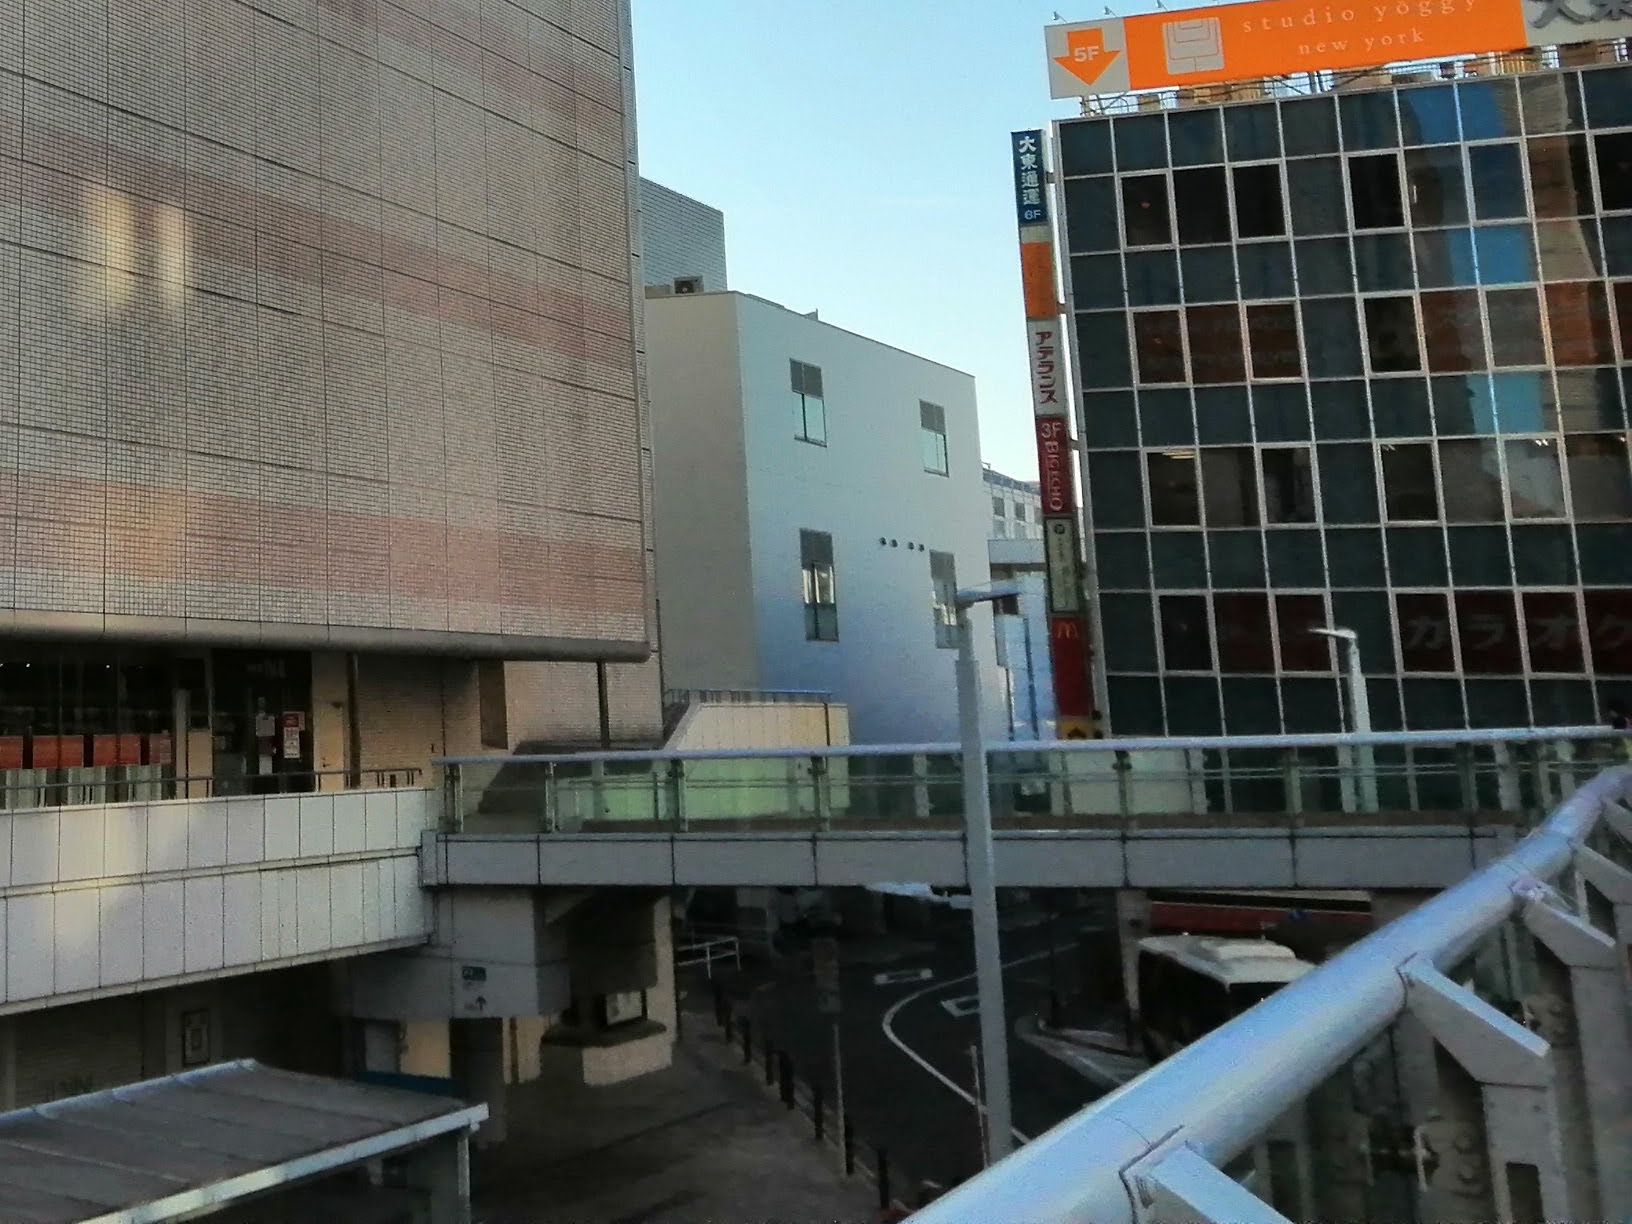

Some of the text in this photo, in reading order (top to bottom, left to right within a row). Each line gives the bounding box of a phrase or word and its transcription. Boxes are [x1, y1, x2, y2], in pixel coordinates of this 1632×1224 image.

[1242, 1, 1355, 33] studio
[1298, 28, 1426, 56] new york
[1074, 45, 1100, 63] 5F
[1018, 135, 1041, 206] 大東通運
[1024, 209, 1042, 221] 6F
[1040, 421, 1063, 439] 3F
